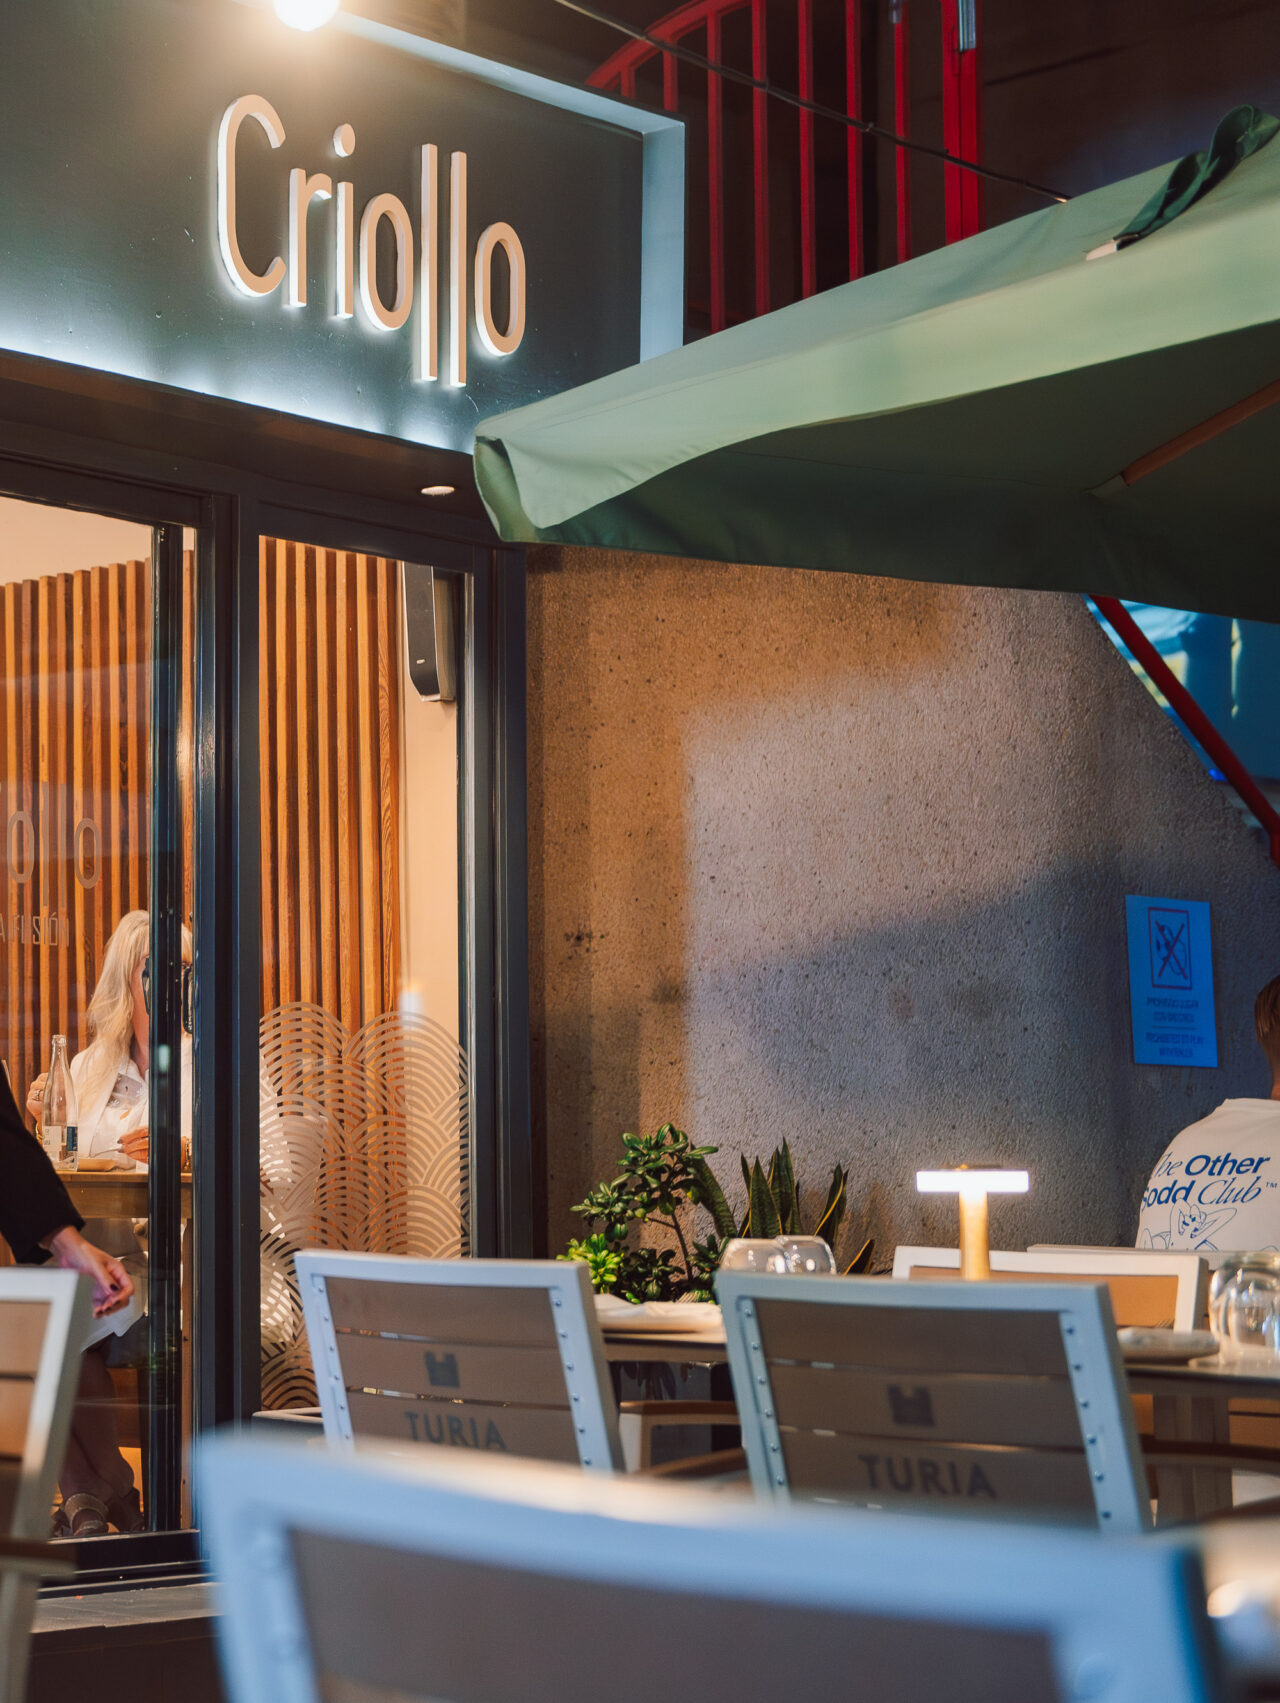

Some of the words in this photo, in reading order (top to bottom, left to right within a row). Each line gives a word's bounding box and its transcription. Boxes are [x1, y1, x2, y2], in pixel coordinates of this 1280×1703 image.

[217, 94, 526, 387] Criollo
[1184, 1152, 1271, 1176] Other
[1197, 1175, 1262, 1205] Club
[404, 1411, 508, 1450] TURIA
[858, 1454, 996, 1498] TURIA
